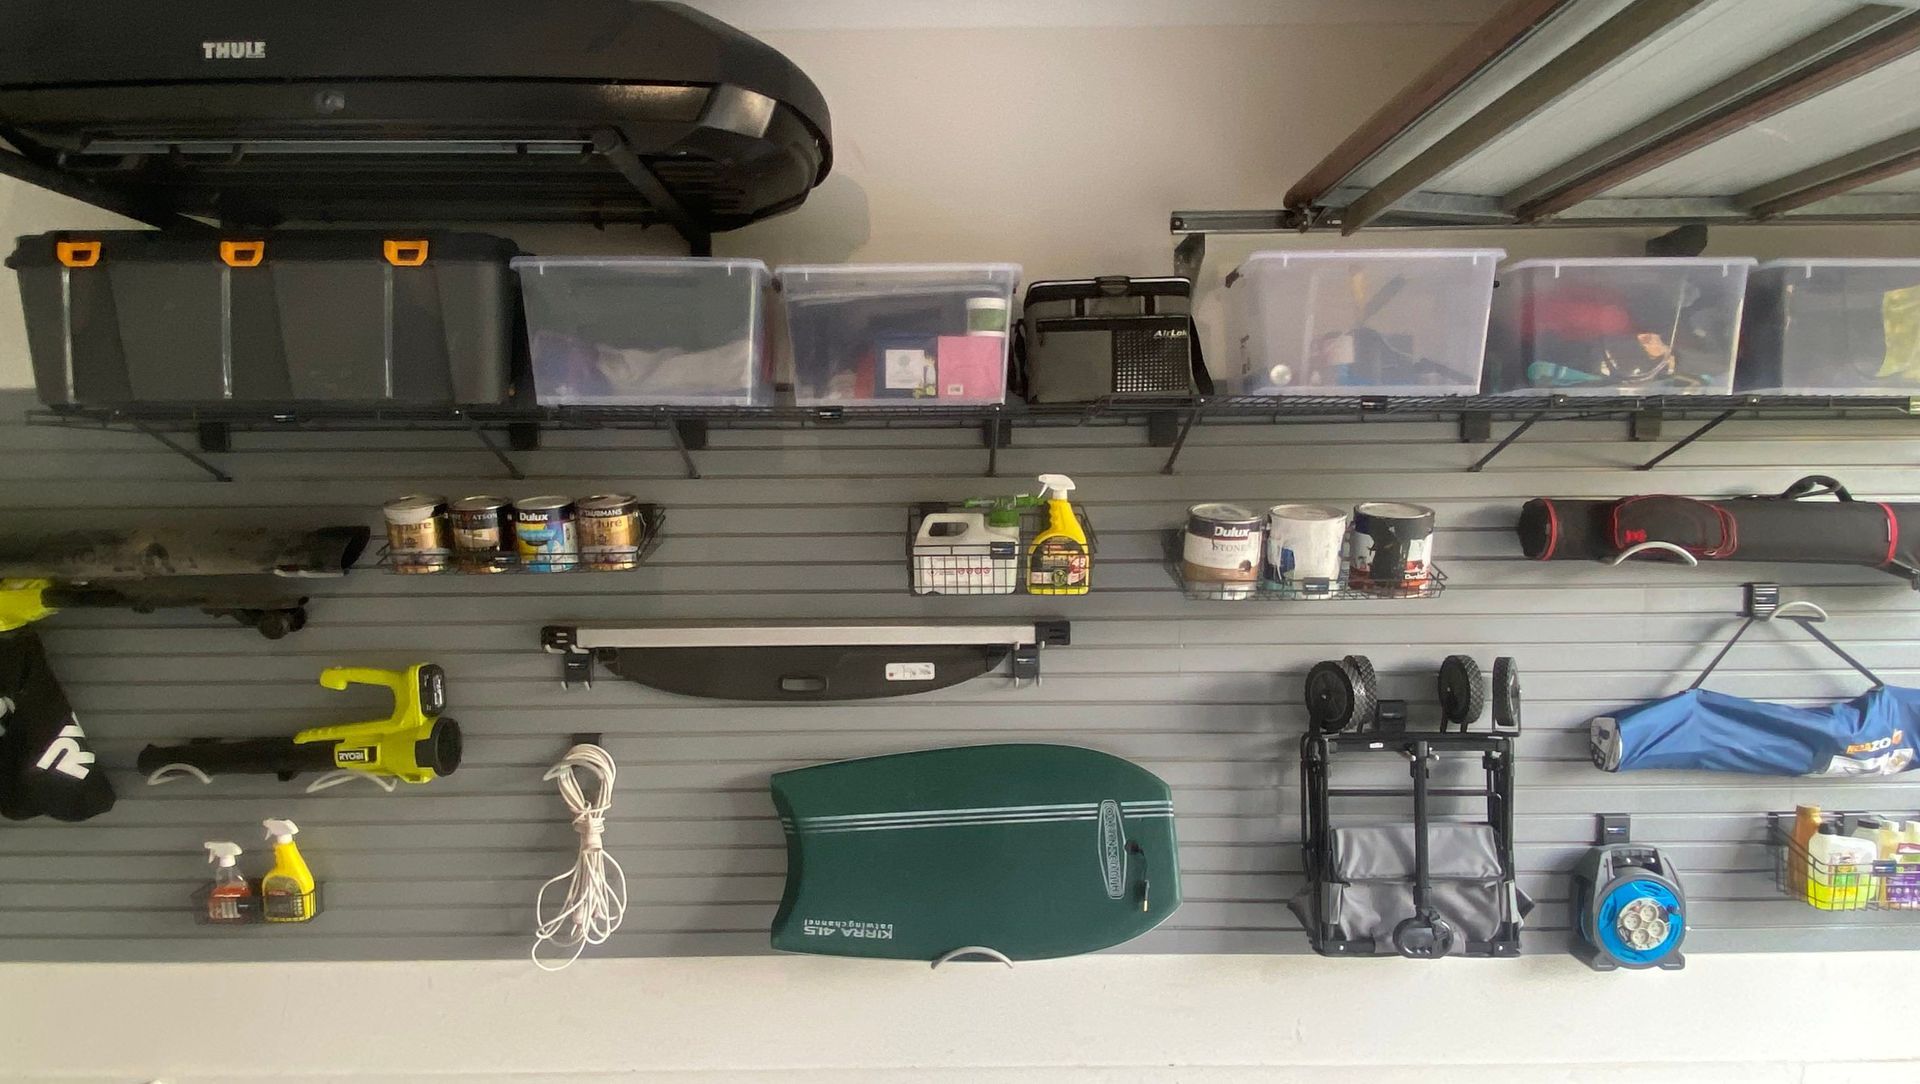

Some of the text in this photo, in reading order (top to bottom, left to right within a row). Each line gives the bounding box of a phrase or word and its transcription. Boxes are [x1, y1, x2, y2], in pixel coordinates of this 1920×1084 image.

[203, 42, 266, 59] THULE
[519, 512, 549, 521] Dulux
[1214, 526, 1250, 537] Dulux
[339, 752, 363, 760] RYOBI
[840, 927, 893, 939] KIRRA
